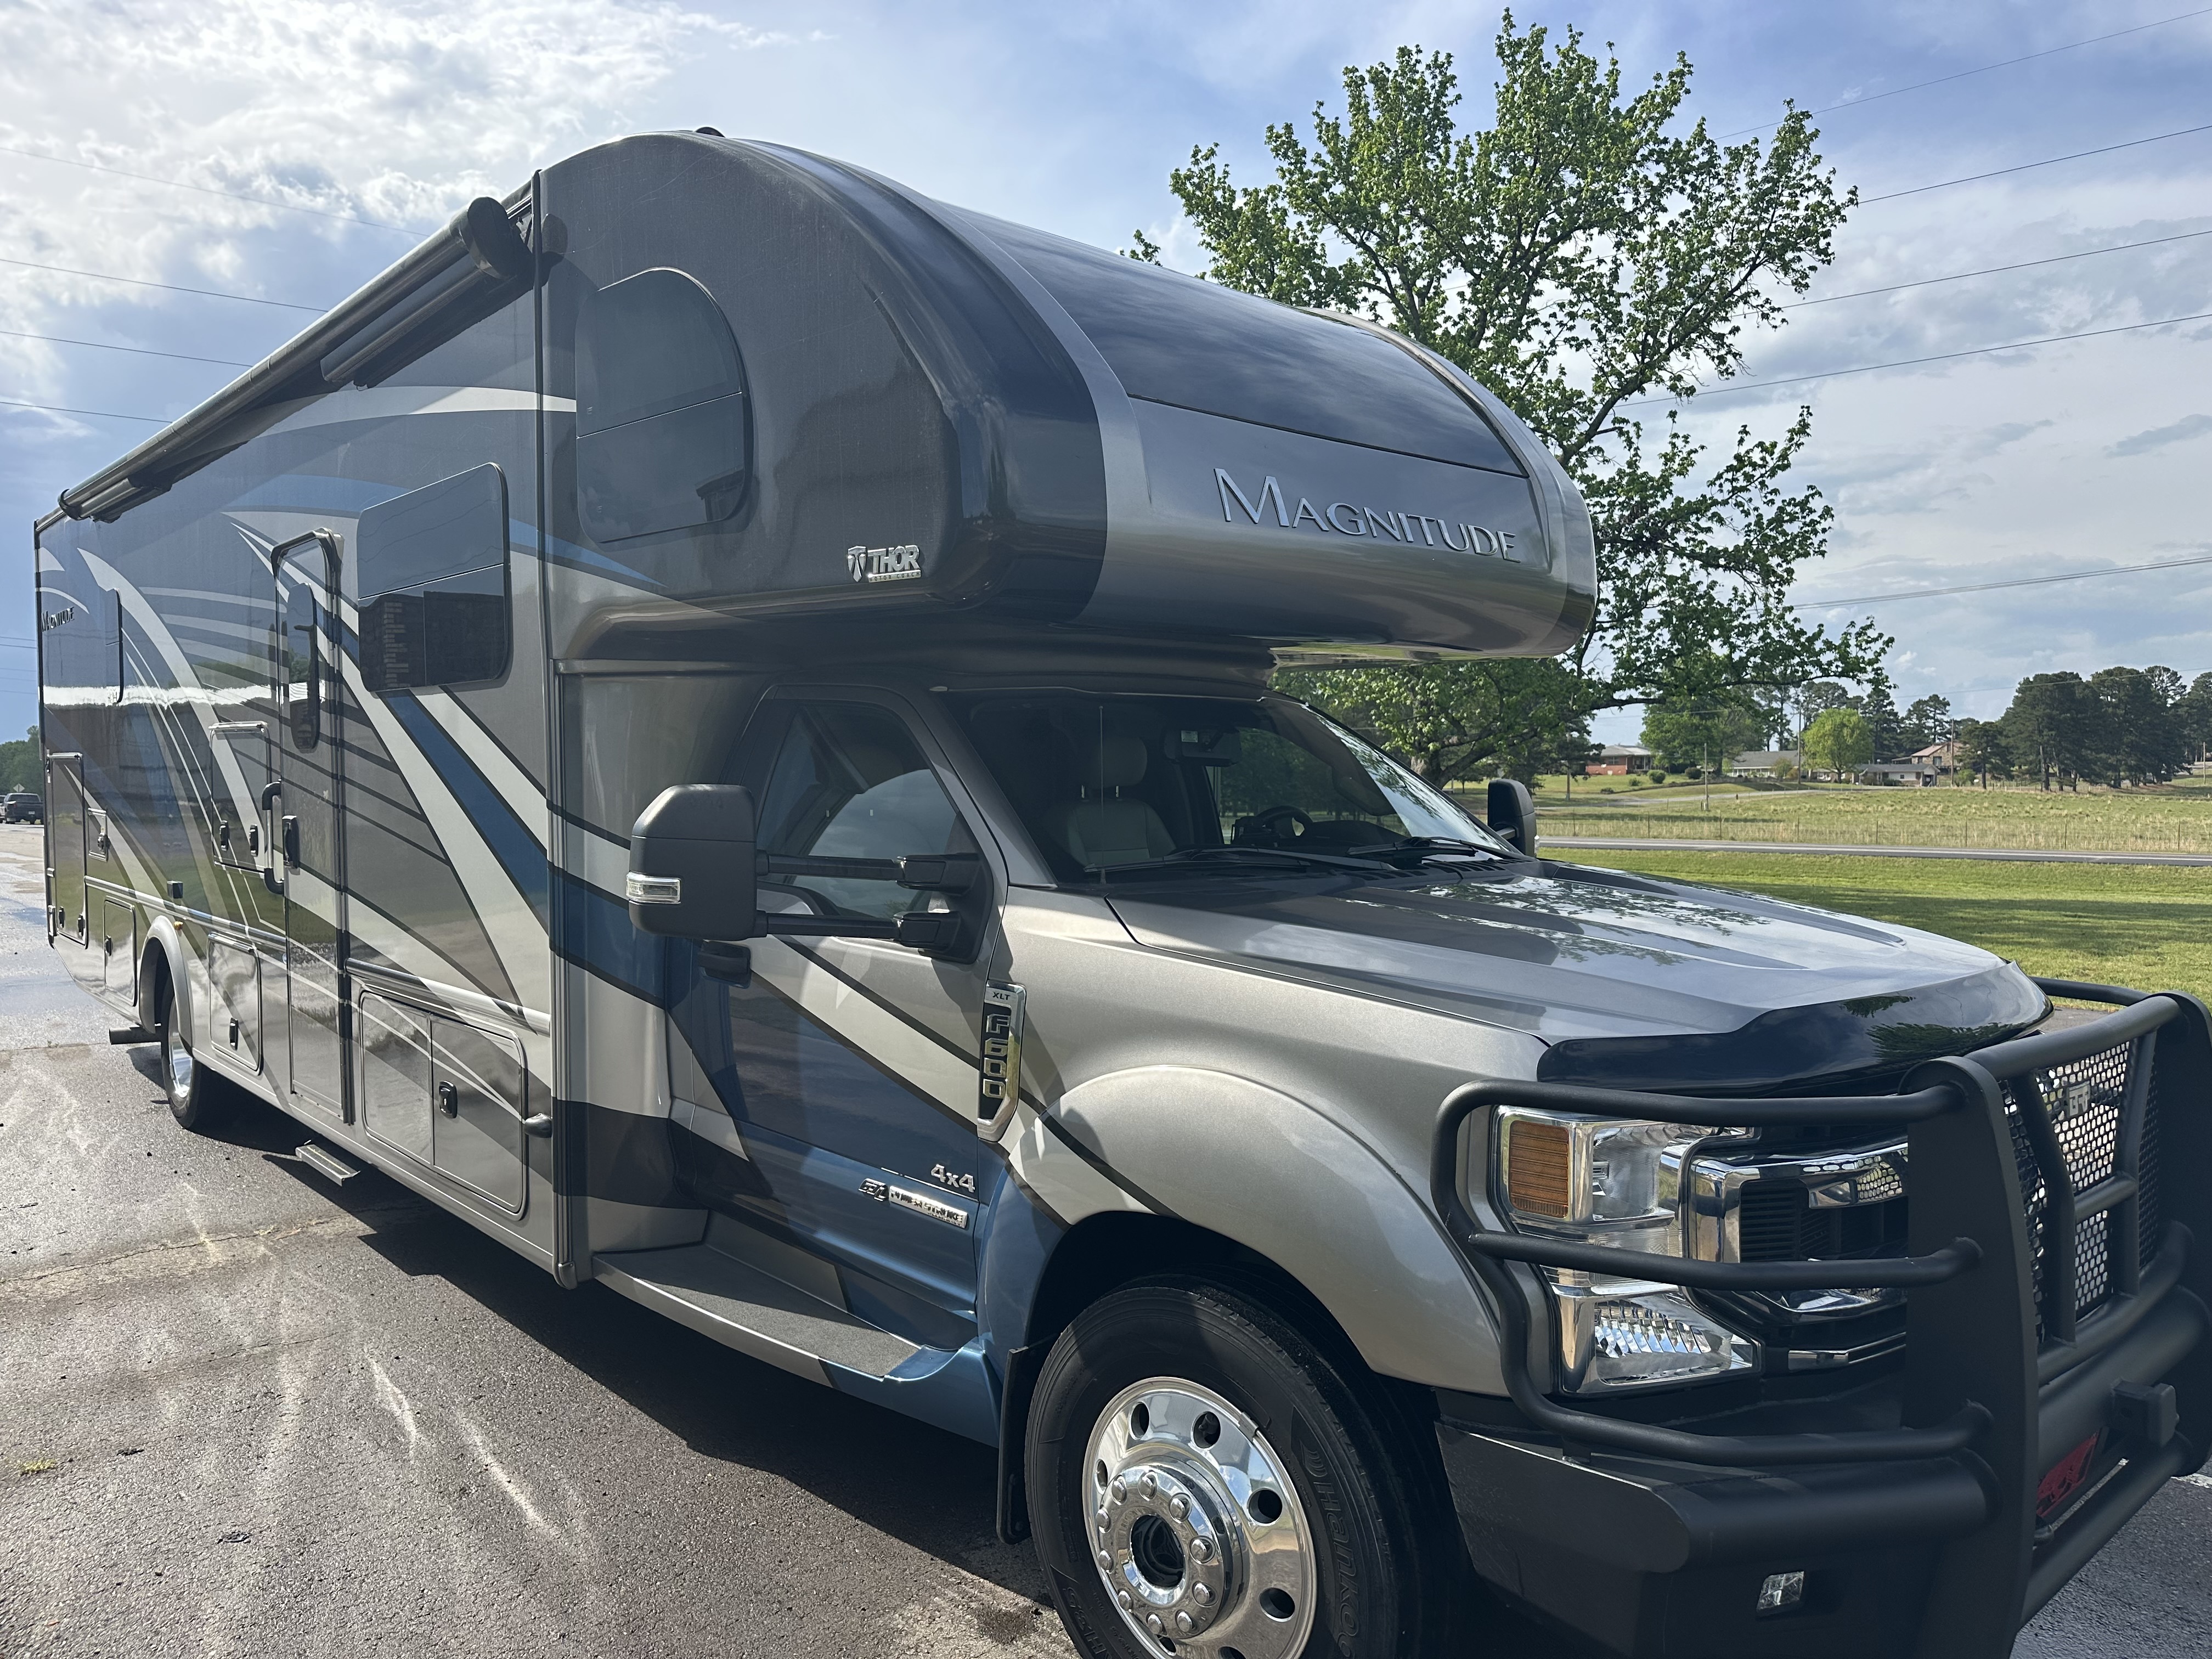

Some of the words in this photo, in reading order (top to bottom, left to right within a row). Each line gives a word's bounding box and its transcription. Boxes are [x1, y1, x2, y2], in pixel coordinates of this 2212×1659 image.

[1213, 467, 1522, 563] MAGNITUDE
[867, 544, 921, 574] THOR
[992, 991, 1011, 1001] XLT
[930, 1163, 976, 1194] 4x4
[1312, 1481, 1359, 1659] Hankoo
